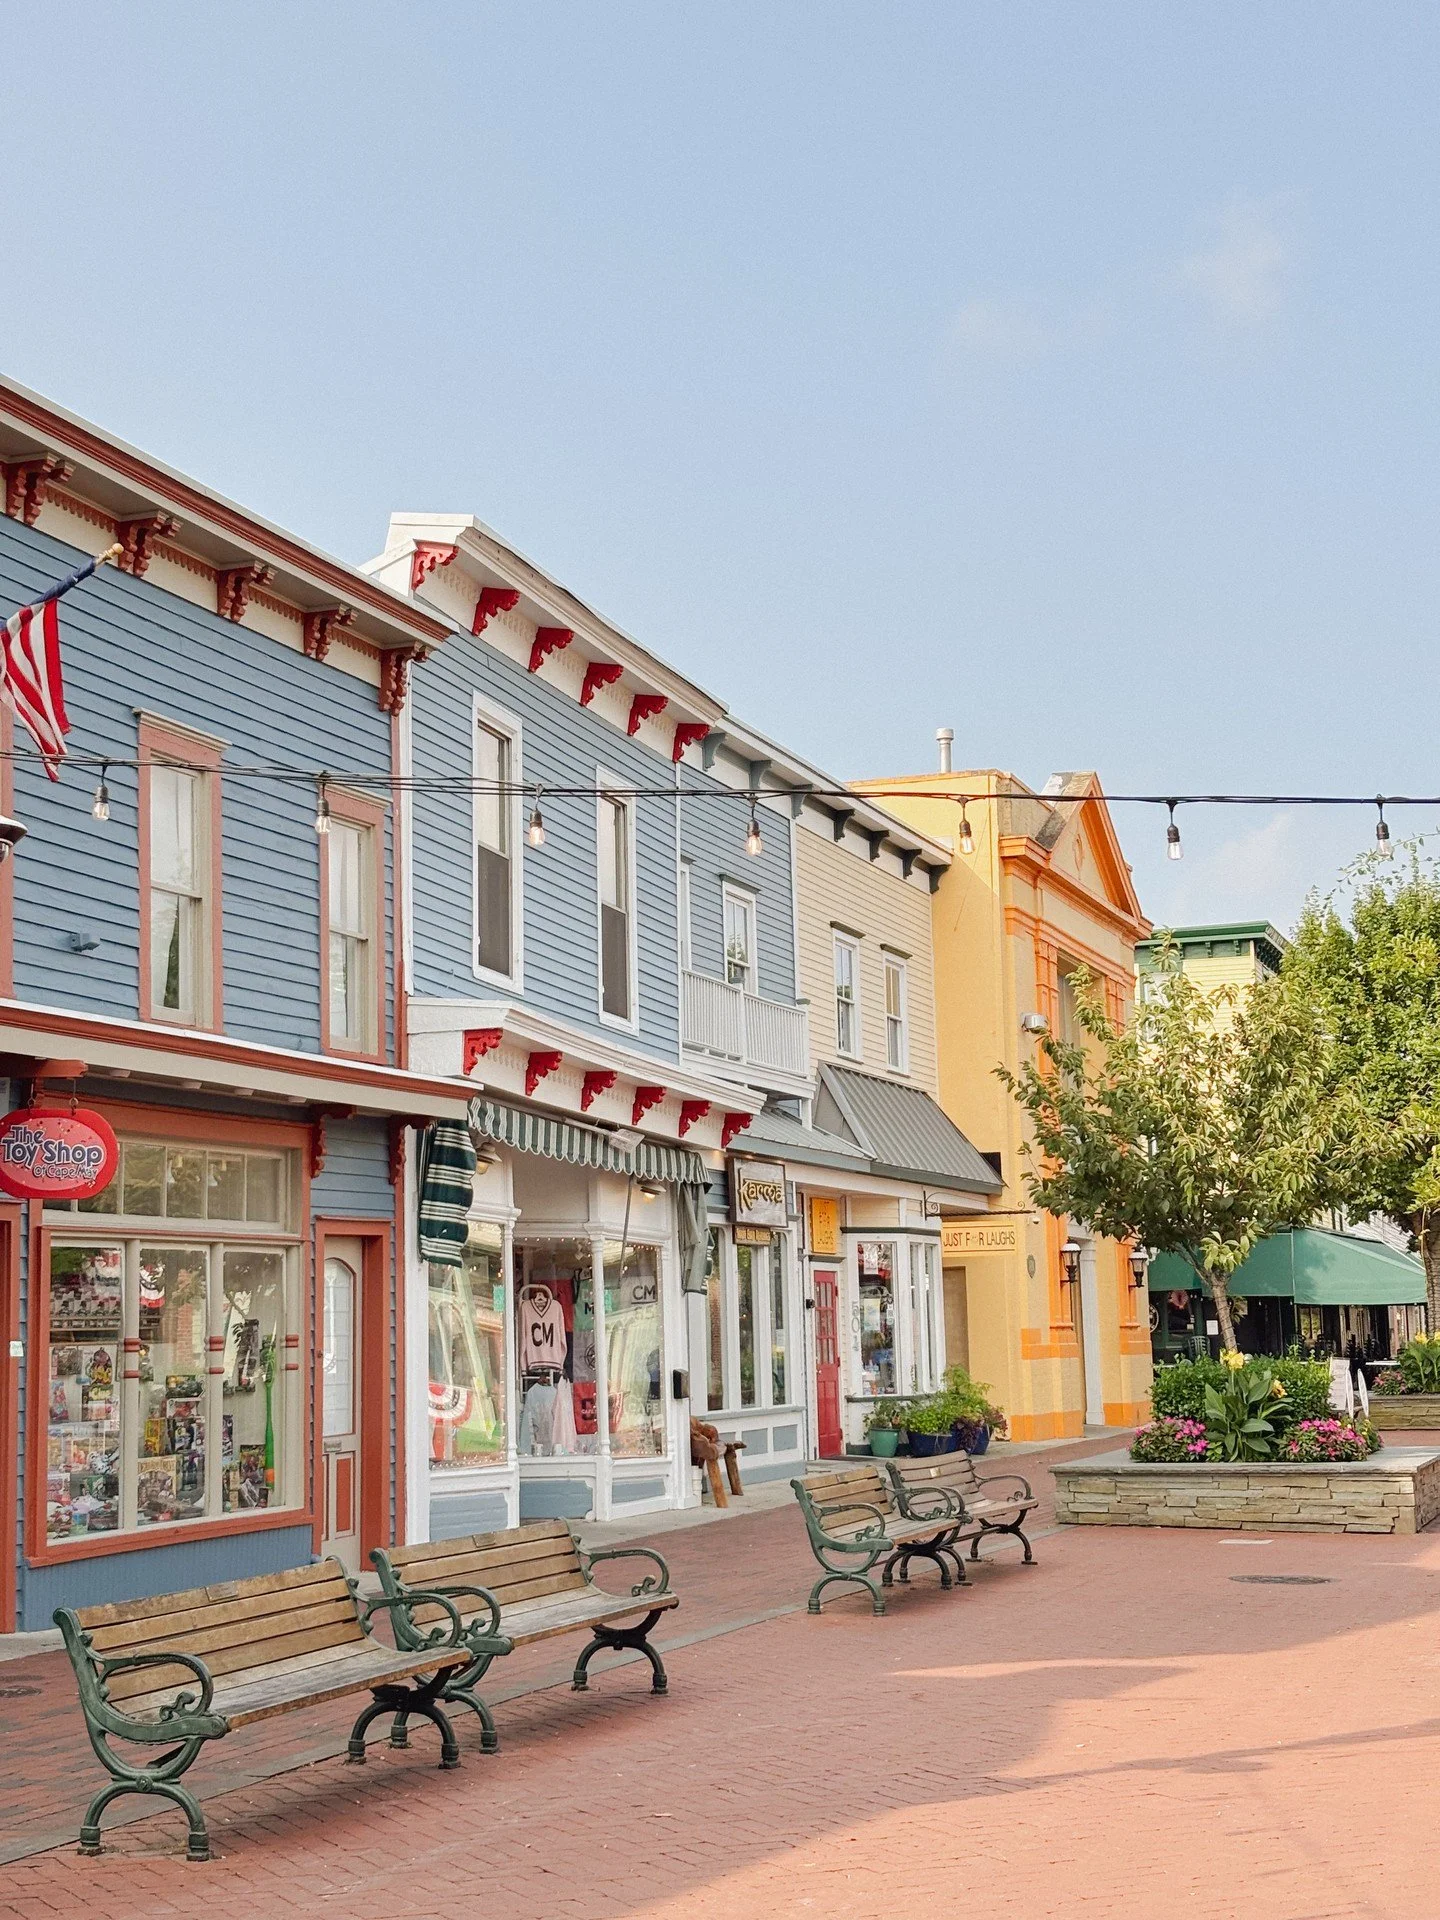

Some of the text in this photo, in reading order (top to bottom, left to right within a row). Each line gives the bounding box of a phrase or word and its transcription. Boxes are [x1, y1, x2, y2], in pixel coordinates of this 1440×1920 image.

[10, 1125, 45, 1144] The
[2, 1138, 104, 1169] Toy Shop
[33, 1164, 98, 1180] of Cape May
[943, 1232, 963, 1247] JUST
[986, 1231, 1015, 1246] LAUGHS
[632, 1285, 656, 1300] CM
[531, 1322, 554, 1348] CM
